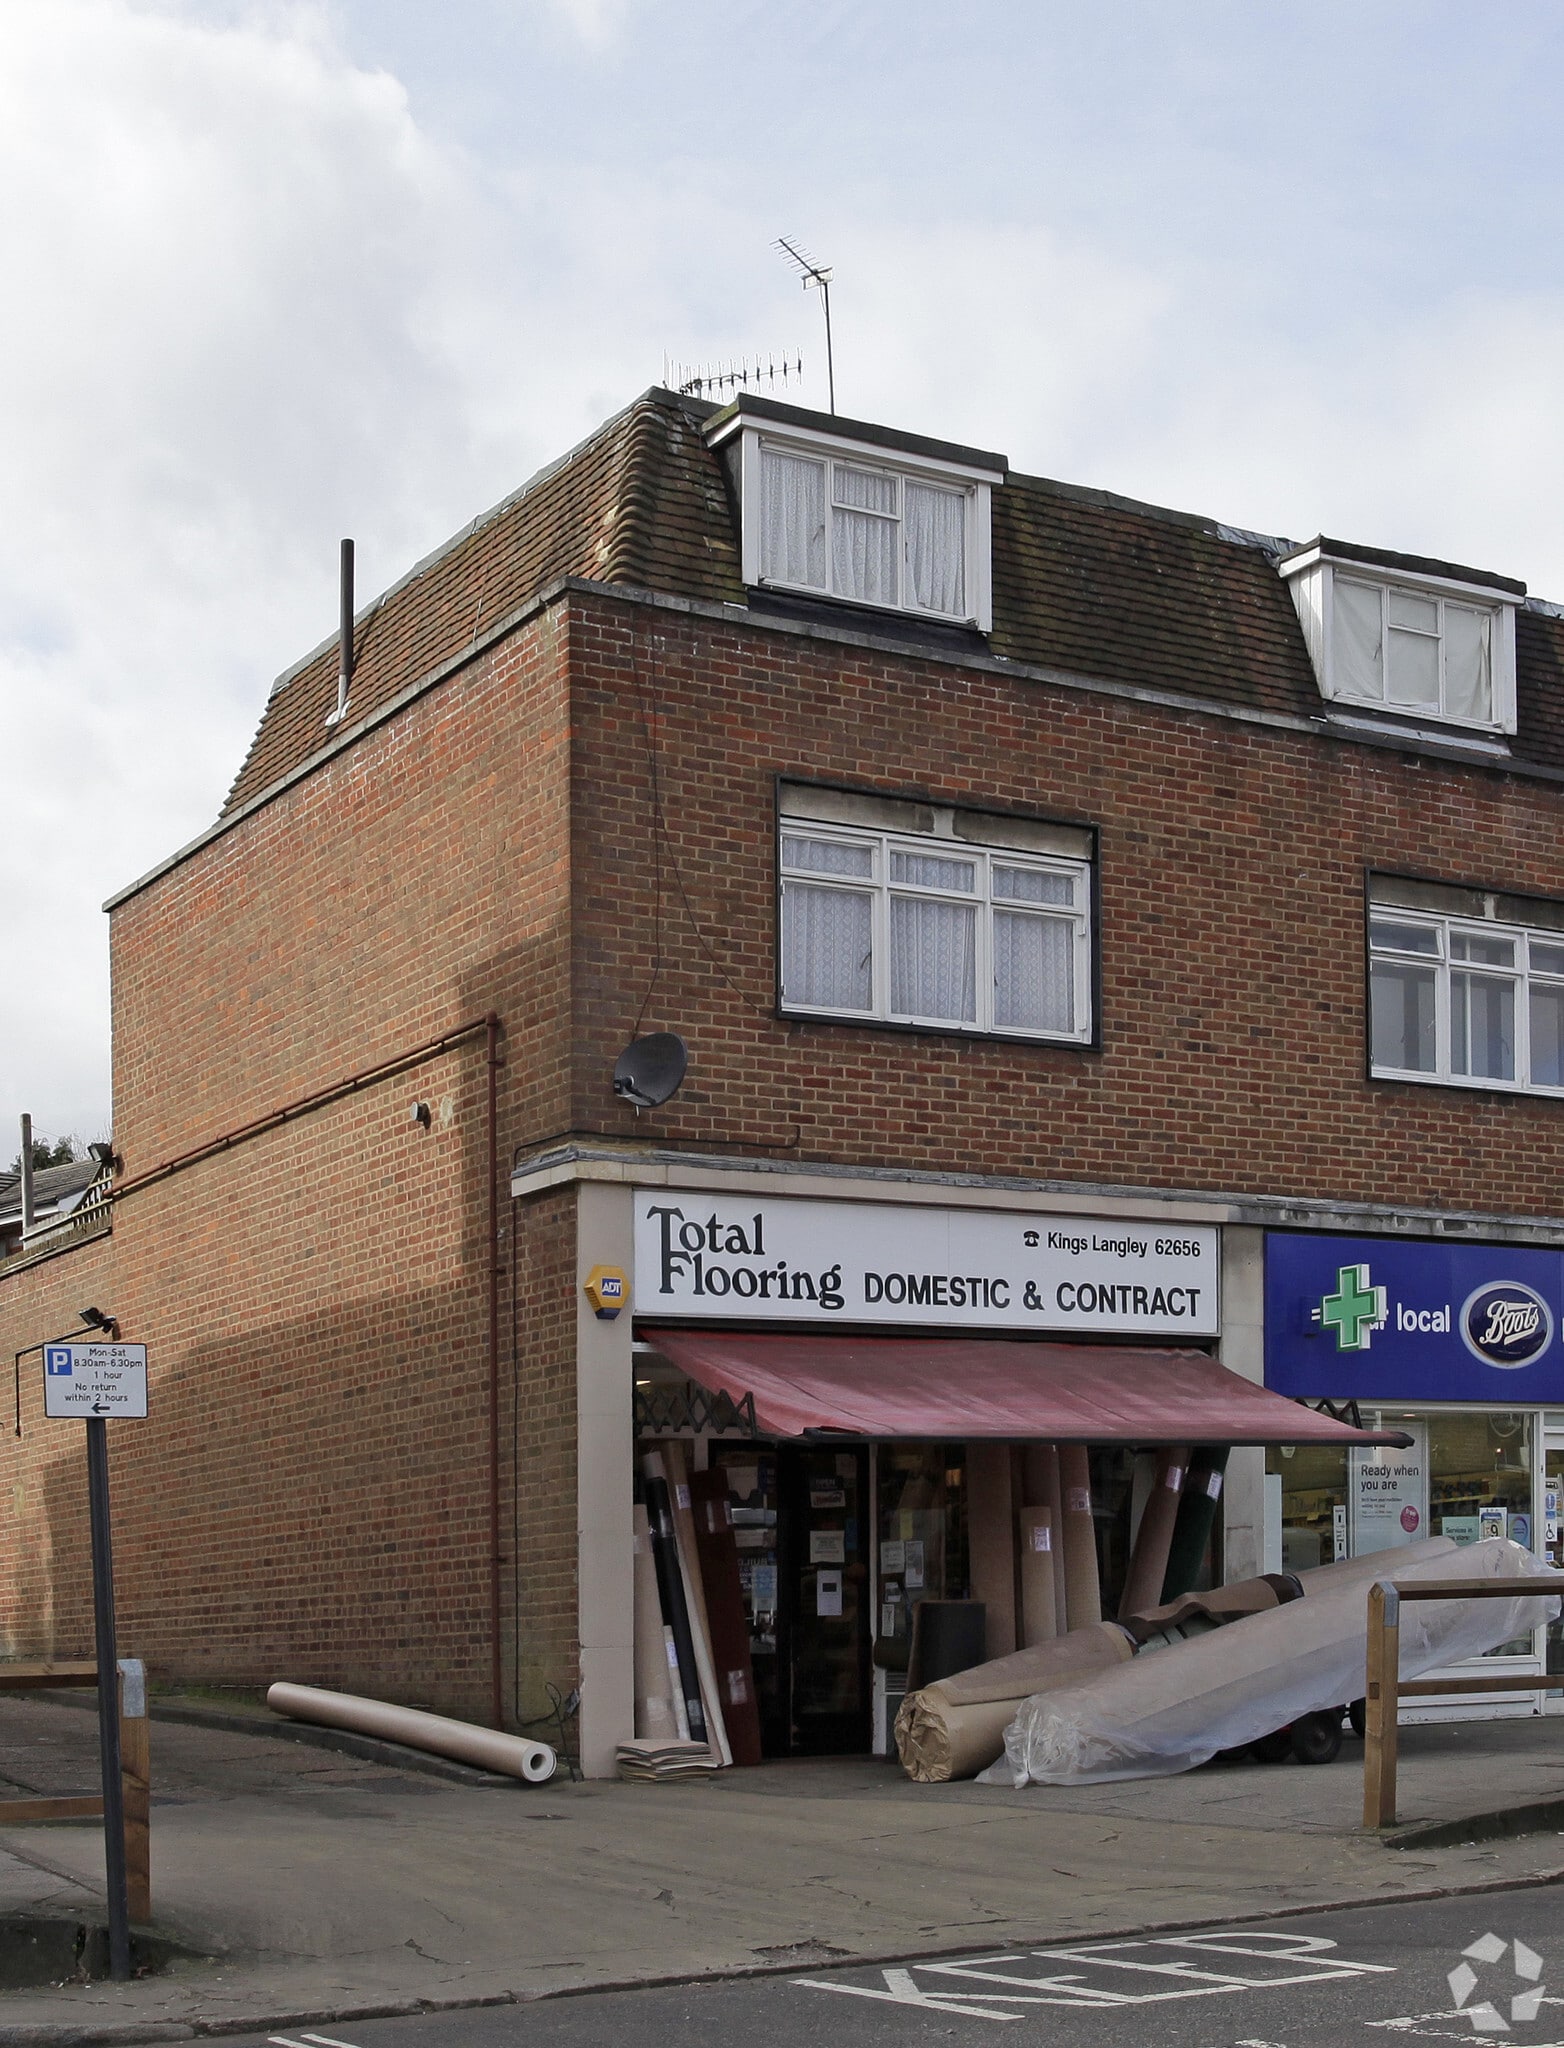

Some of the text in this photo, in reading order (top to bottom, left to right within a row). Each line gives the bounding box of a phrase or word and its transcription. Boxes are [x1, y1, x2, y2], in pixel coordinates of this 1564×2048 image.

[646, 1205, 766, 1255] Total
[1047, 1231, 1201, 1258] Kings Langley 62656
[601, 1281, 622, 1294] ADT
[659, 1250, 846, 1310] Flooring
[863, 1272, 1202, 1317] DOMESTIC & CONTRACT
[1396, 1302, 1450, 1333] local
[1478, 1300, 1540, 1346] Boots
[88, 1347, 127, 1357] Mon-Sat
[52, 1351, 69, 1374] P
[73, 1358, 143, 1369] 8.30am-6.30pm
[94, 1371, 123, 1379] 1 hour
[75, 1383, 117, 1391] No return
[64, 1393, 128, 1402] within 2 hours
[1361, 1464, 1419, 1479] Ready when
[1360, 1480, 1398, 1493] you are
[787, 1932, 1397, 2021] KEEP
